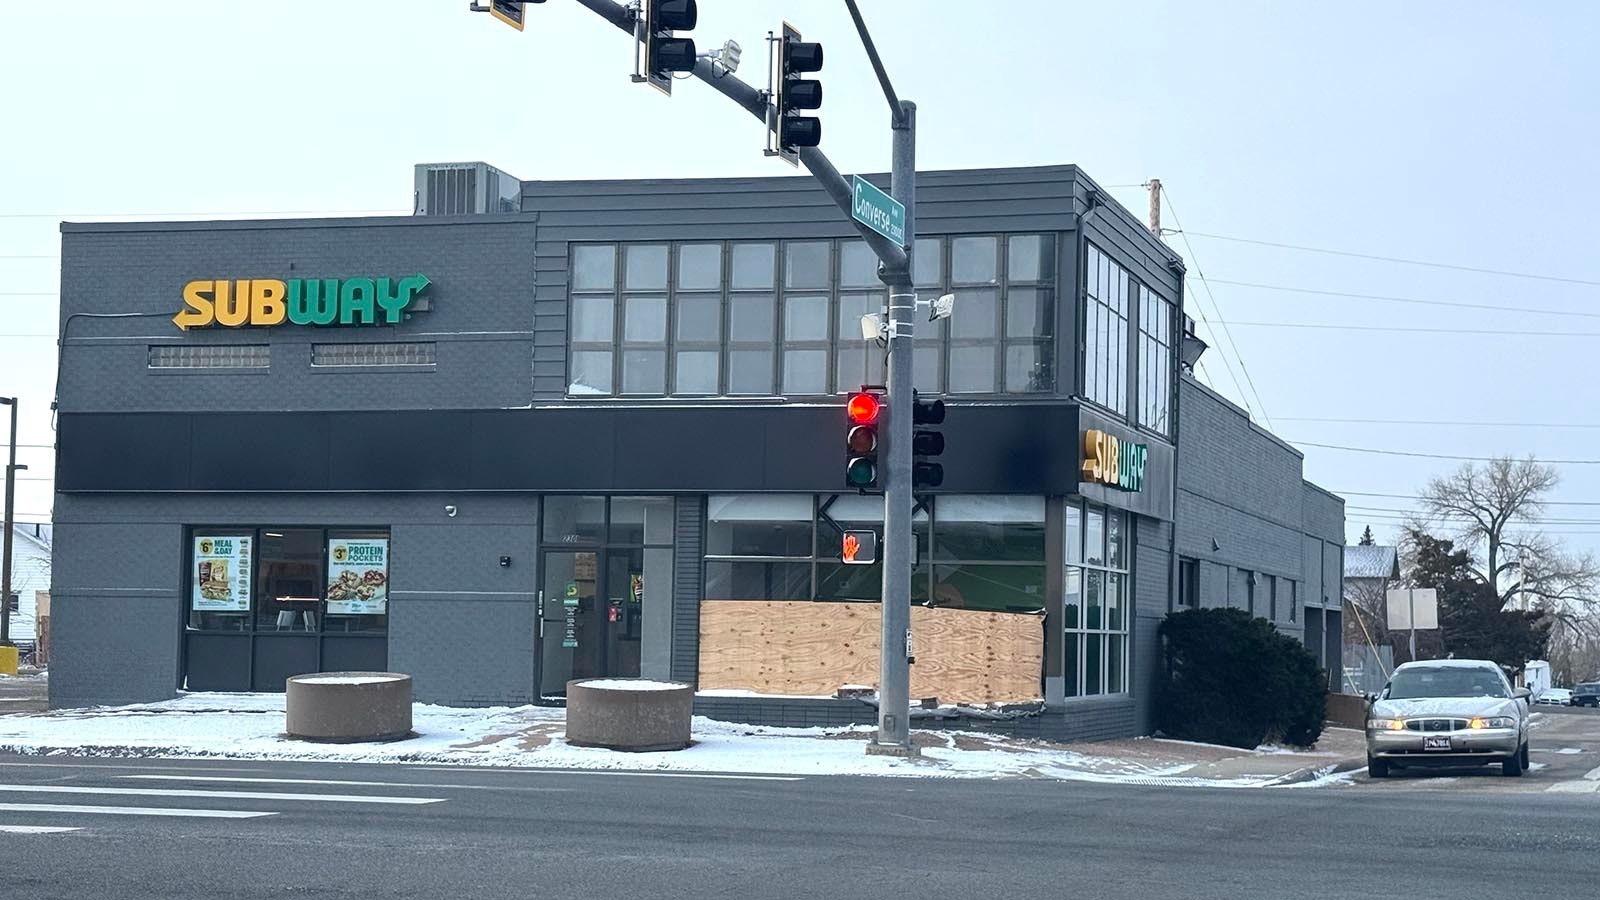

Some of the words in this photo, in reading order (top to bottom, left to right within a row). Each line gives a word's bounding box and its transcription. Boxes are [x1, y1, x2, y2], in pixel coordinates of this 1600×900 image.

[855, 183, 890, 232] Converse
[172, 272, 432, 331] SUBWAY
[1083, 429, 1148, 492] SUBWAY
[214, 540, 232, 548] MEAL
[348, 546, 383, 555] PROTEIN
